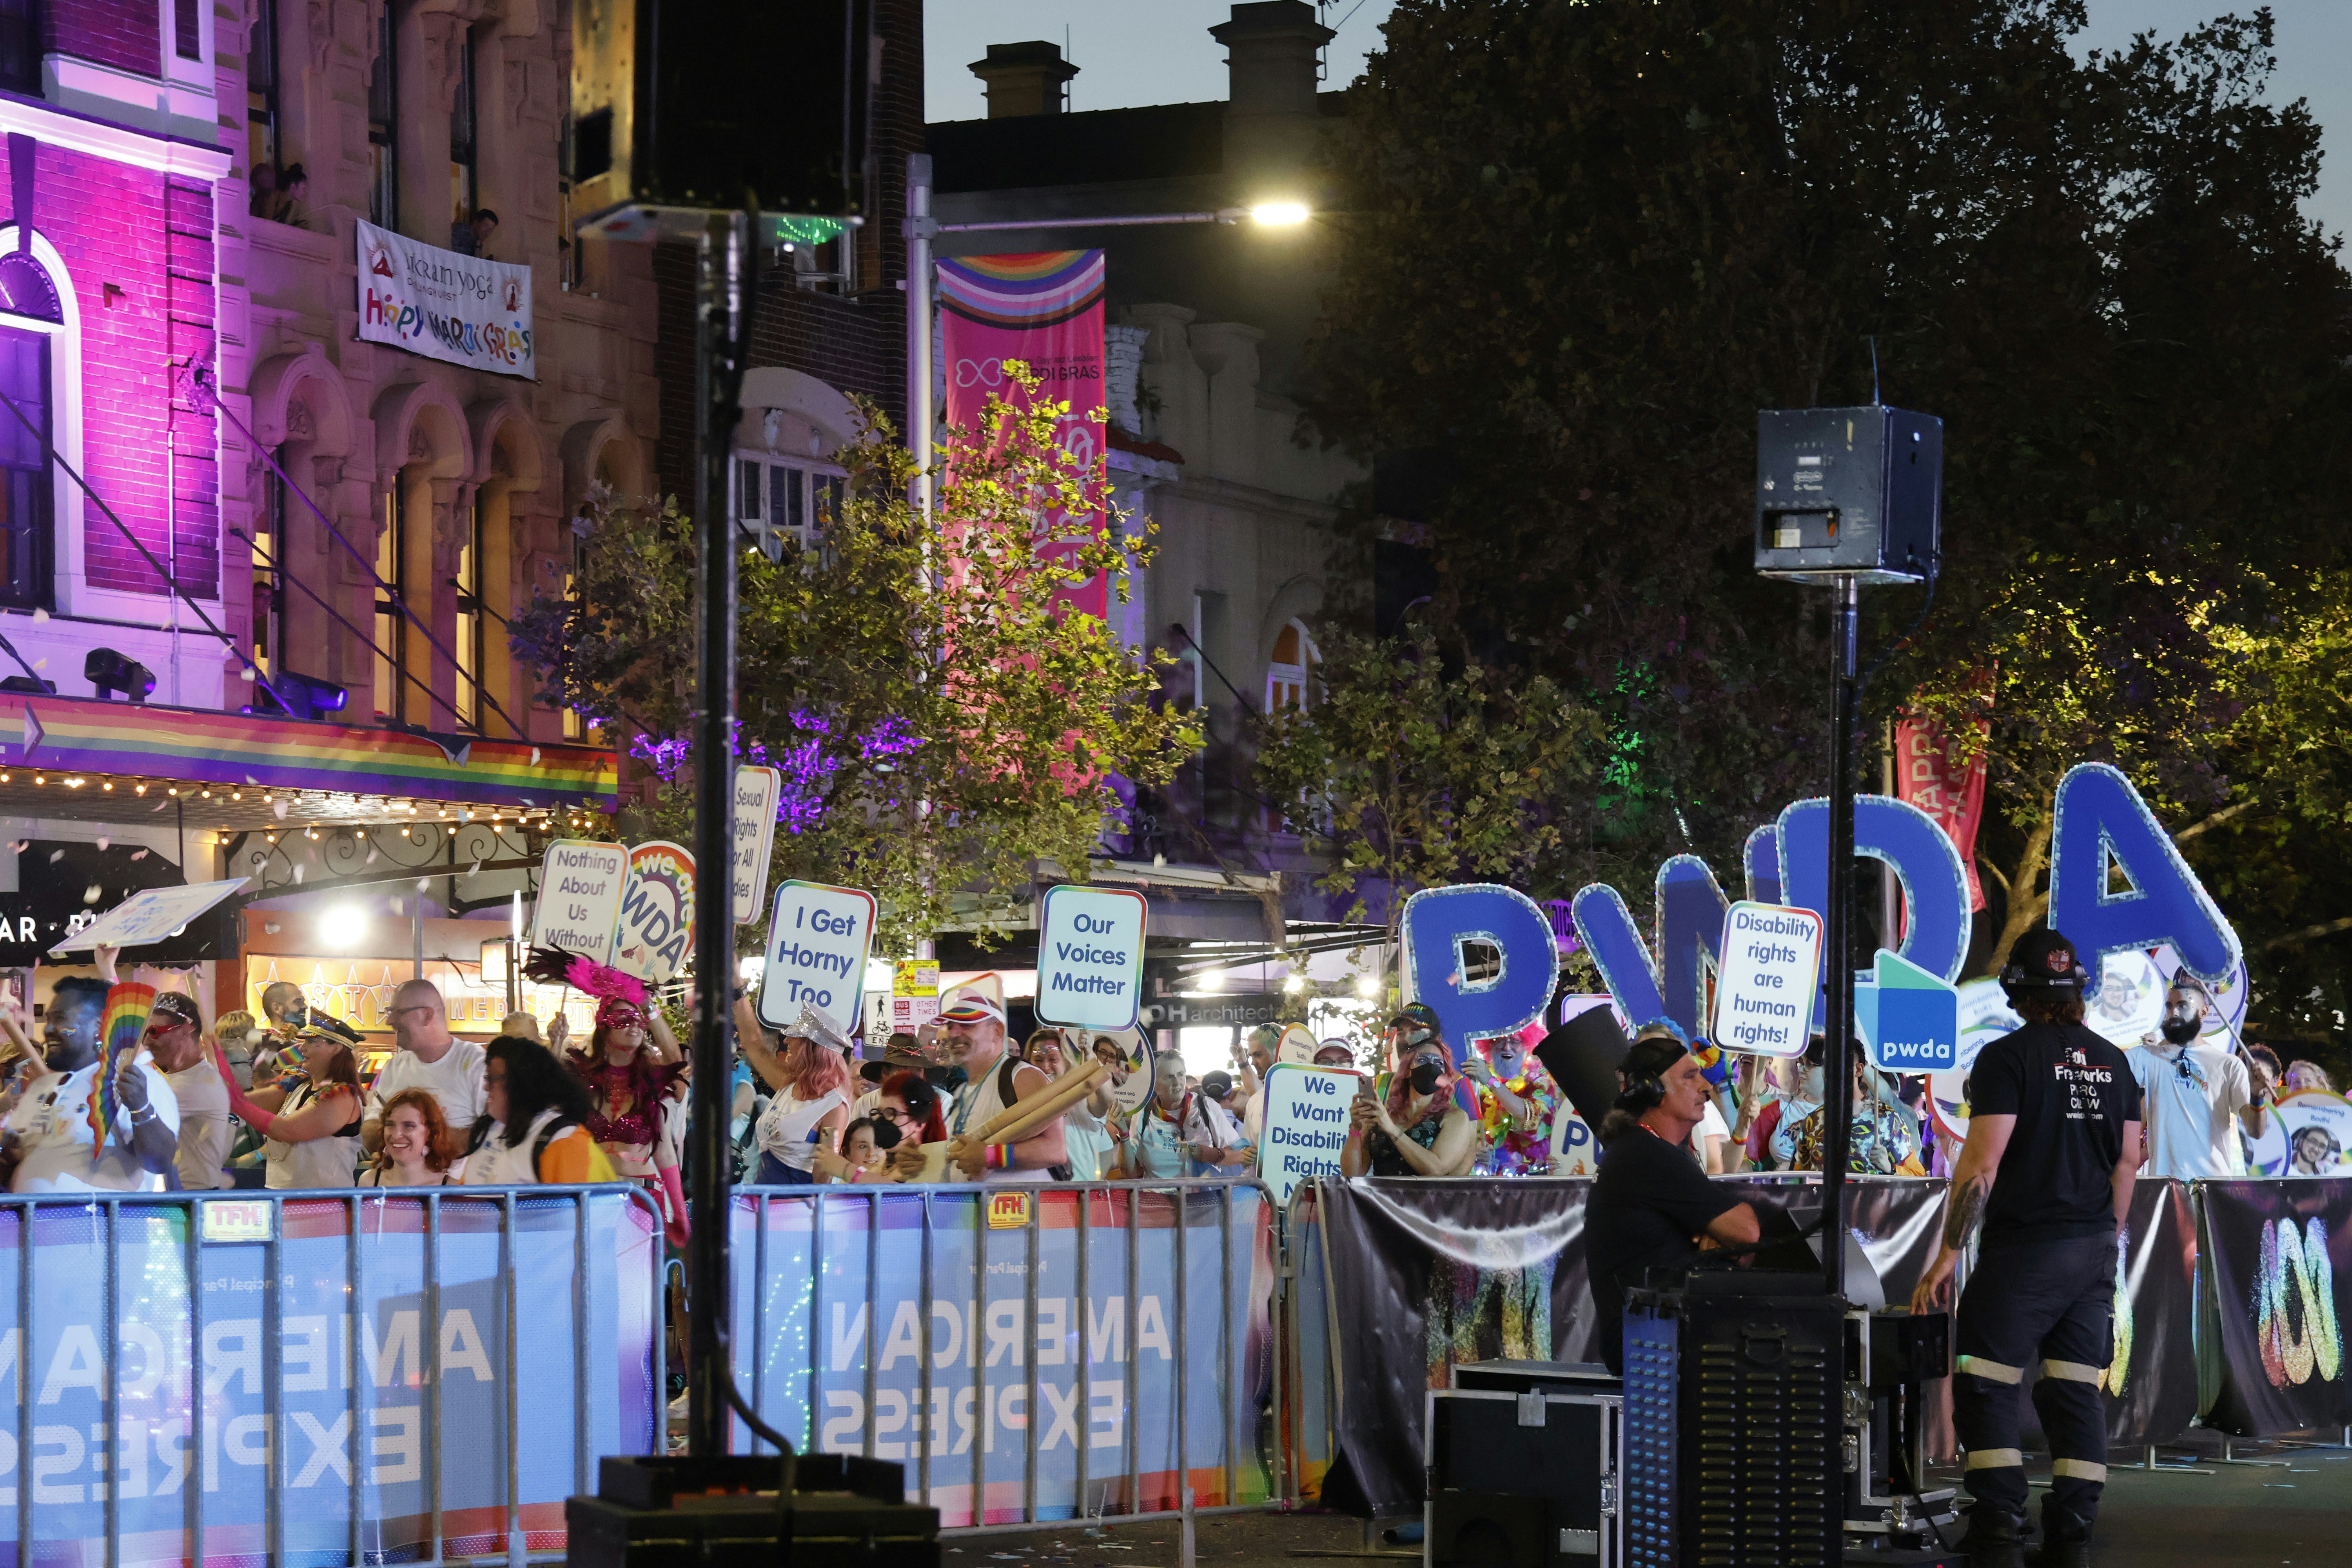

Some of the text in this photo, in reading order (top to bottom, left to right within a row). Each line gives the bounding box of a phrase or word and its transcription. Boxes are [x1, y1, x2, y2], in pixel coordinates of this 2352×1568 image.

[457, 271, 493, 300] yoga
[483, 322, 530, 365] GRAS
[1059, 365, 1100, 380] GRAS
[736, 787, 764, 807] Sexual
[734, 817, 758, 841] Rights
[557, 851, 617, 875] Nothing
[733, 848, 754, 867] or All
[559, 877, 606, 895] About
[733, 877, 750, 898] dies
[676, 873, 696, 922] are
[569, 904, 587, 921] Us
[796, 906, 856, 936] I Get
[621, 880, 685, 972] WDA
[1074, 914, 1114, 935] Our
[1737, 913, 1815, 942] Disability
[545, 928, 604, 948] Without
[778, 941, 853, 979] Horny
[1056, 942, 1126, 965] Voices
[1748, 944, 1796, 964] rights
[1051, 972, 1126, 996] Matter
[1754, 973, 1783, 988] are
[788, 979, 831, 1008] Too
[450, 989, 549, 1022] KEBB
[1191, 1004, 1274, 1021] architect
[1734, 994, 1796, 1018] human
[1733, 1024, 1788, 1044] rights!
[1883, 1038, 1950, 1061] pwda
[1304, 1076, 1336, 1095] We
[1292, 1102, 1344, 1123] Want
[2298, 1101, 2345, 1117] Remembering
[1272, 1127, 1347, 1150] Disabilit
[1283, 1155, 1341, 1178] Rights
[211, 1205, 258, 1225] TFH
[995, 1196, 1021, 1214] TFH
